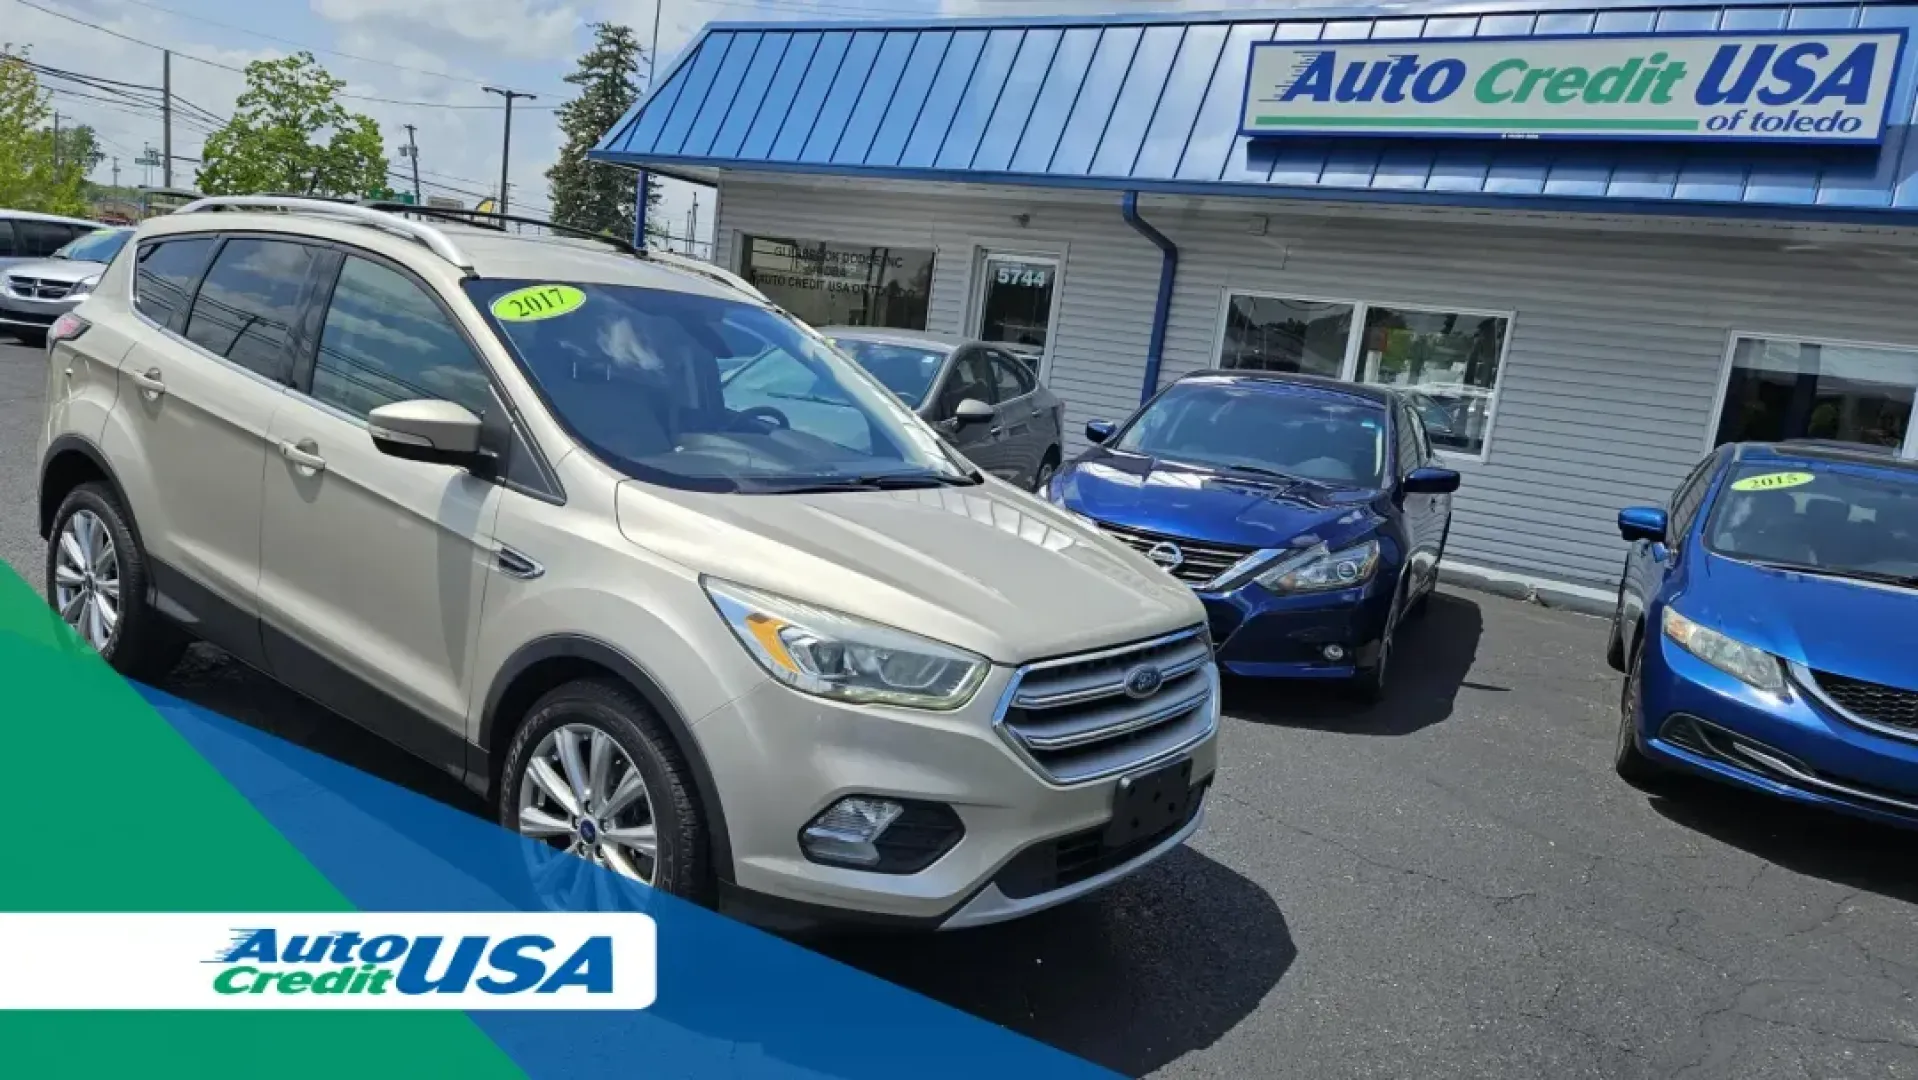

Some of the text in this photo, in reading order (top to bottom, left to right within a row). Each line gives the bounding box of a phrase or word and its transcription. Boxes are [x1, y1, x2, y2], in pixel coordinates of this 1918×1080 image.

[1279, 42, 1878, 106] Auto Credit USA
[1706, 109, 1861, 133] of toledo
[884, 255, 903, 269] NC
[789, 276, 826, 291] CREDIT
[828, 279, 850, 294] USA
[997, 267, 1045, 288] 5744
[508, 287, 564, 316] 2017
[1751, 474, 1799, 489] 2015
